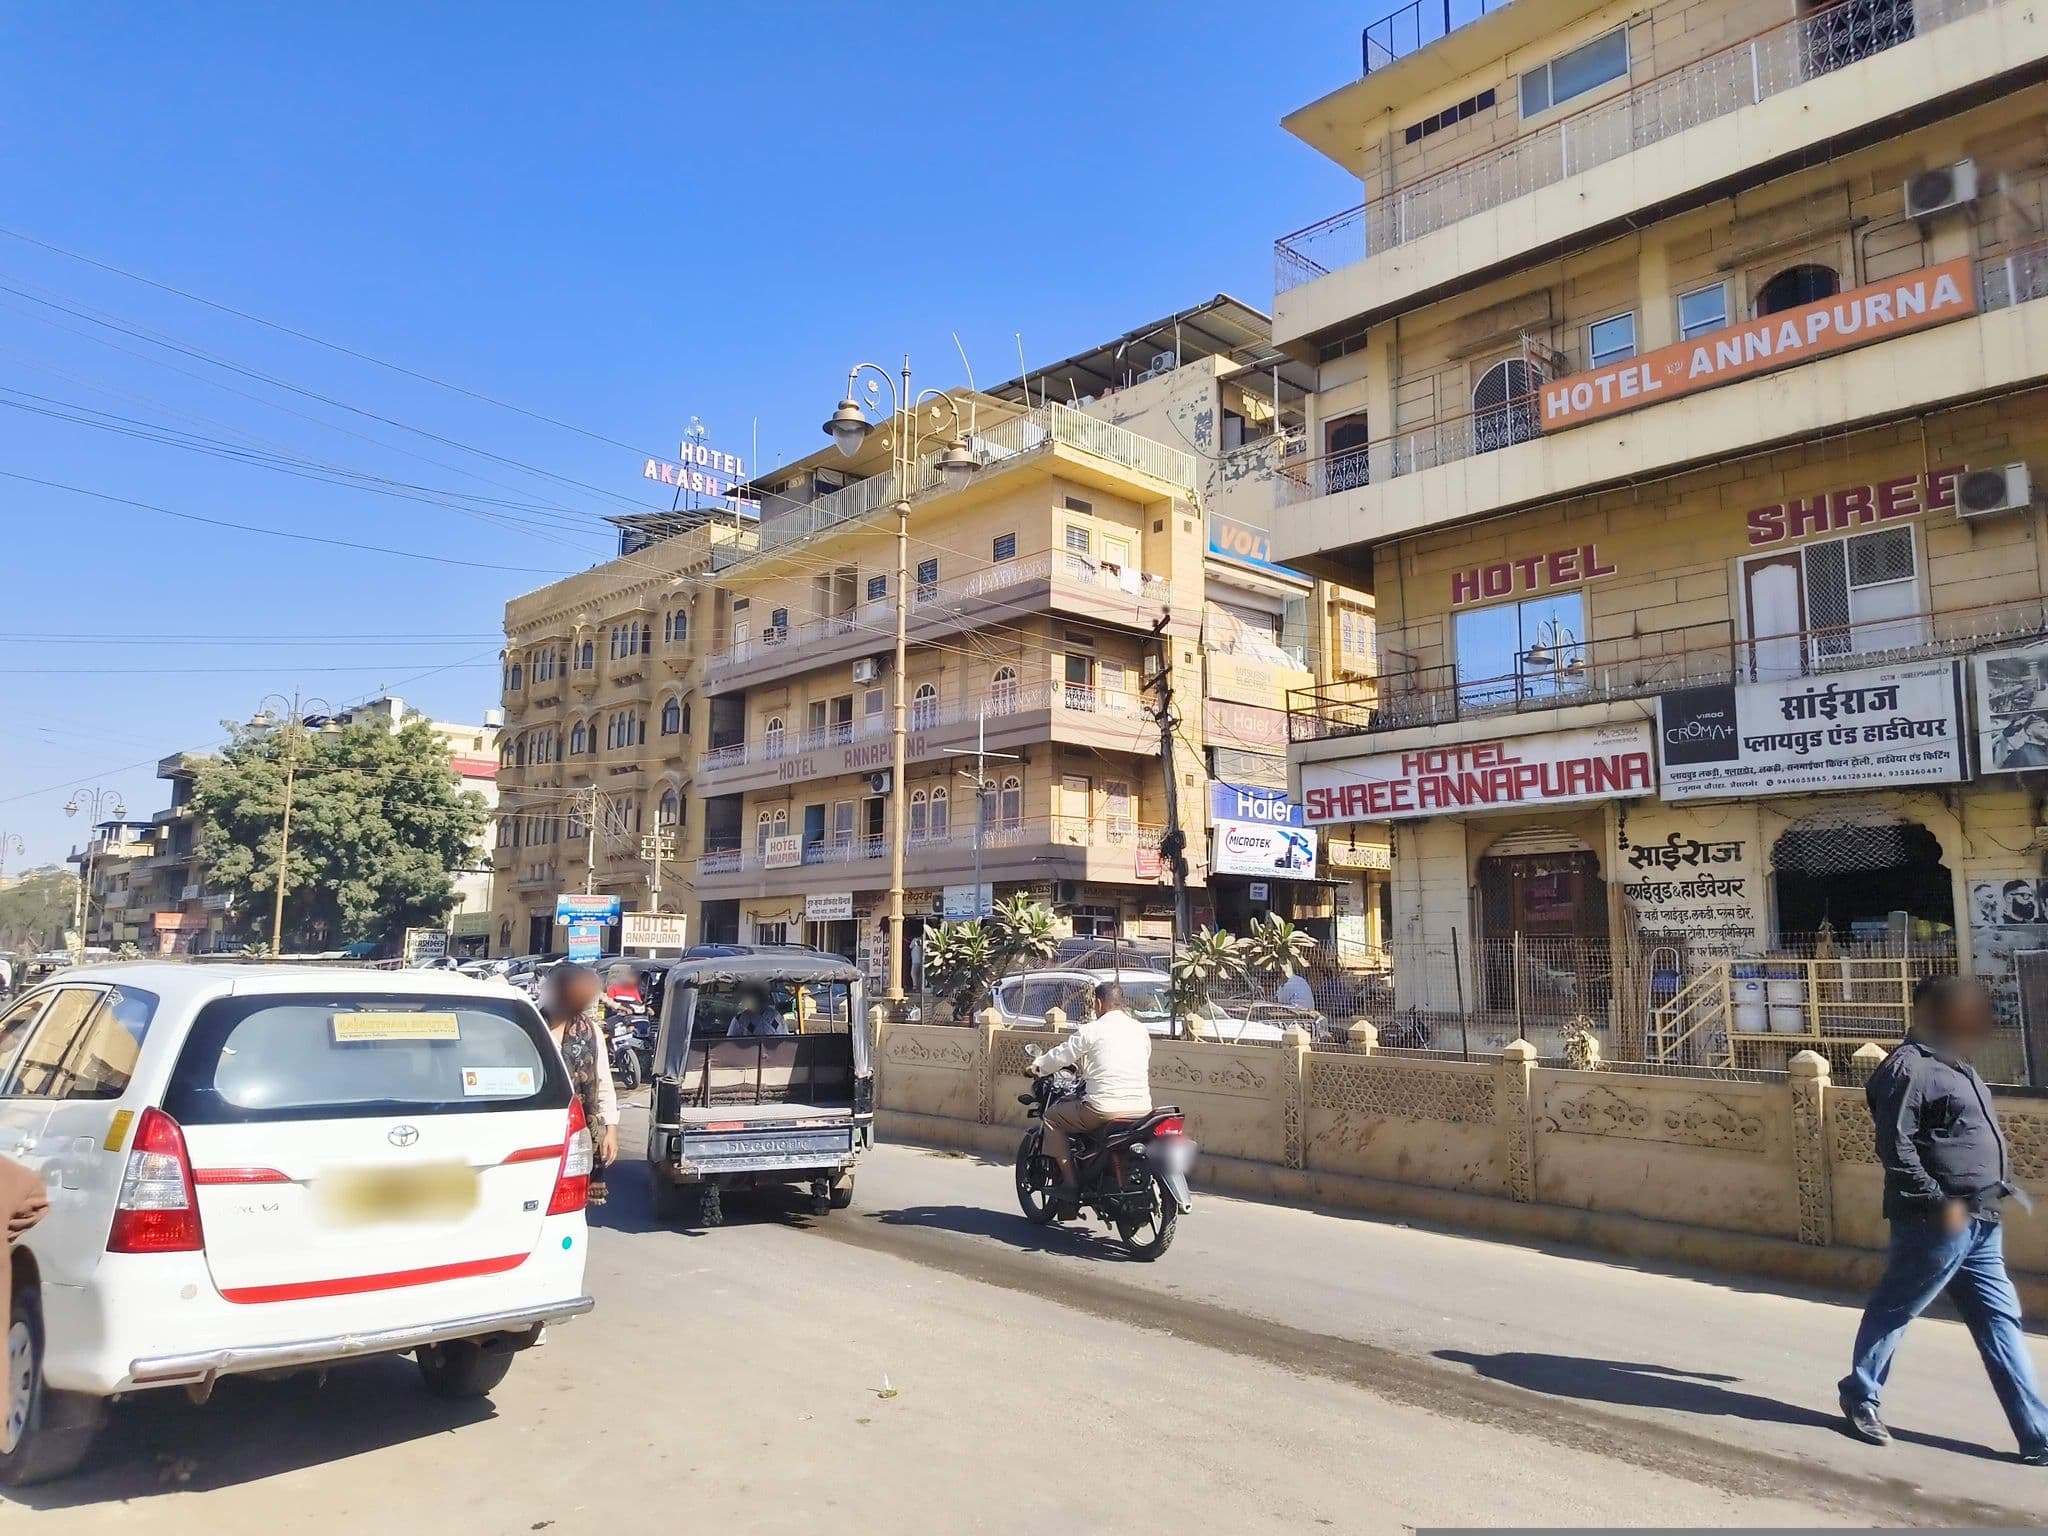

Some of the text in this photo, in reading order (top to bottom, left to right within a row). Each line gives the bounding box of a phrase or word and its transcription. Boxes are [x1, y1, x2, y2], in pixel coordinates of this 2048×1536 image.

[1547, 273, 1963, 419] HOTEL ANNAPURNA
[680, 440, 745, 477] HOTEL
[644, 459, 718, 497] AKASH
[1748, 466, 1965, 545] SHREE
[1453, 544, 1617, 604] HOTEL
[1233, 711, 1271, 733] Haier
[1743, 716, 1948, 755] प्लायवुड एंड हार्डवेयर
[779, 736, 925, 780] HOTEL ANNAPUNA
[1402, 742, 1521, 776] HOTEL
[1306, 752, 1651, 820] SHREE ANNAPURNA
[1238, 790, 1293, 822] Haier
[767, 851, 800, 865] ANNAPURNA
[770, 839, 797, 852] HOTEL
[1229, 835, 1271, 849] MICROTEK
[1628, 832, 1746, 871] साईराज
[1680, 873, 1746, 899] हार्डवेयर
[626, 932, 680, 943] ANNAPURNA
[632, 917, 677, 932] HOTEL
